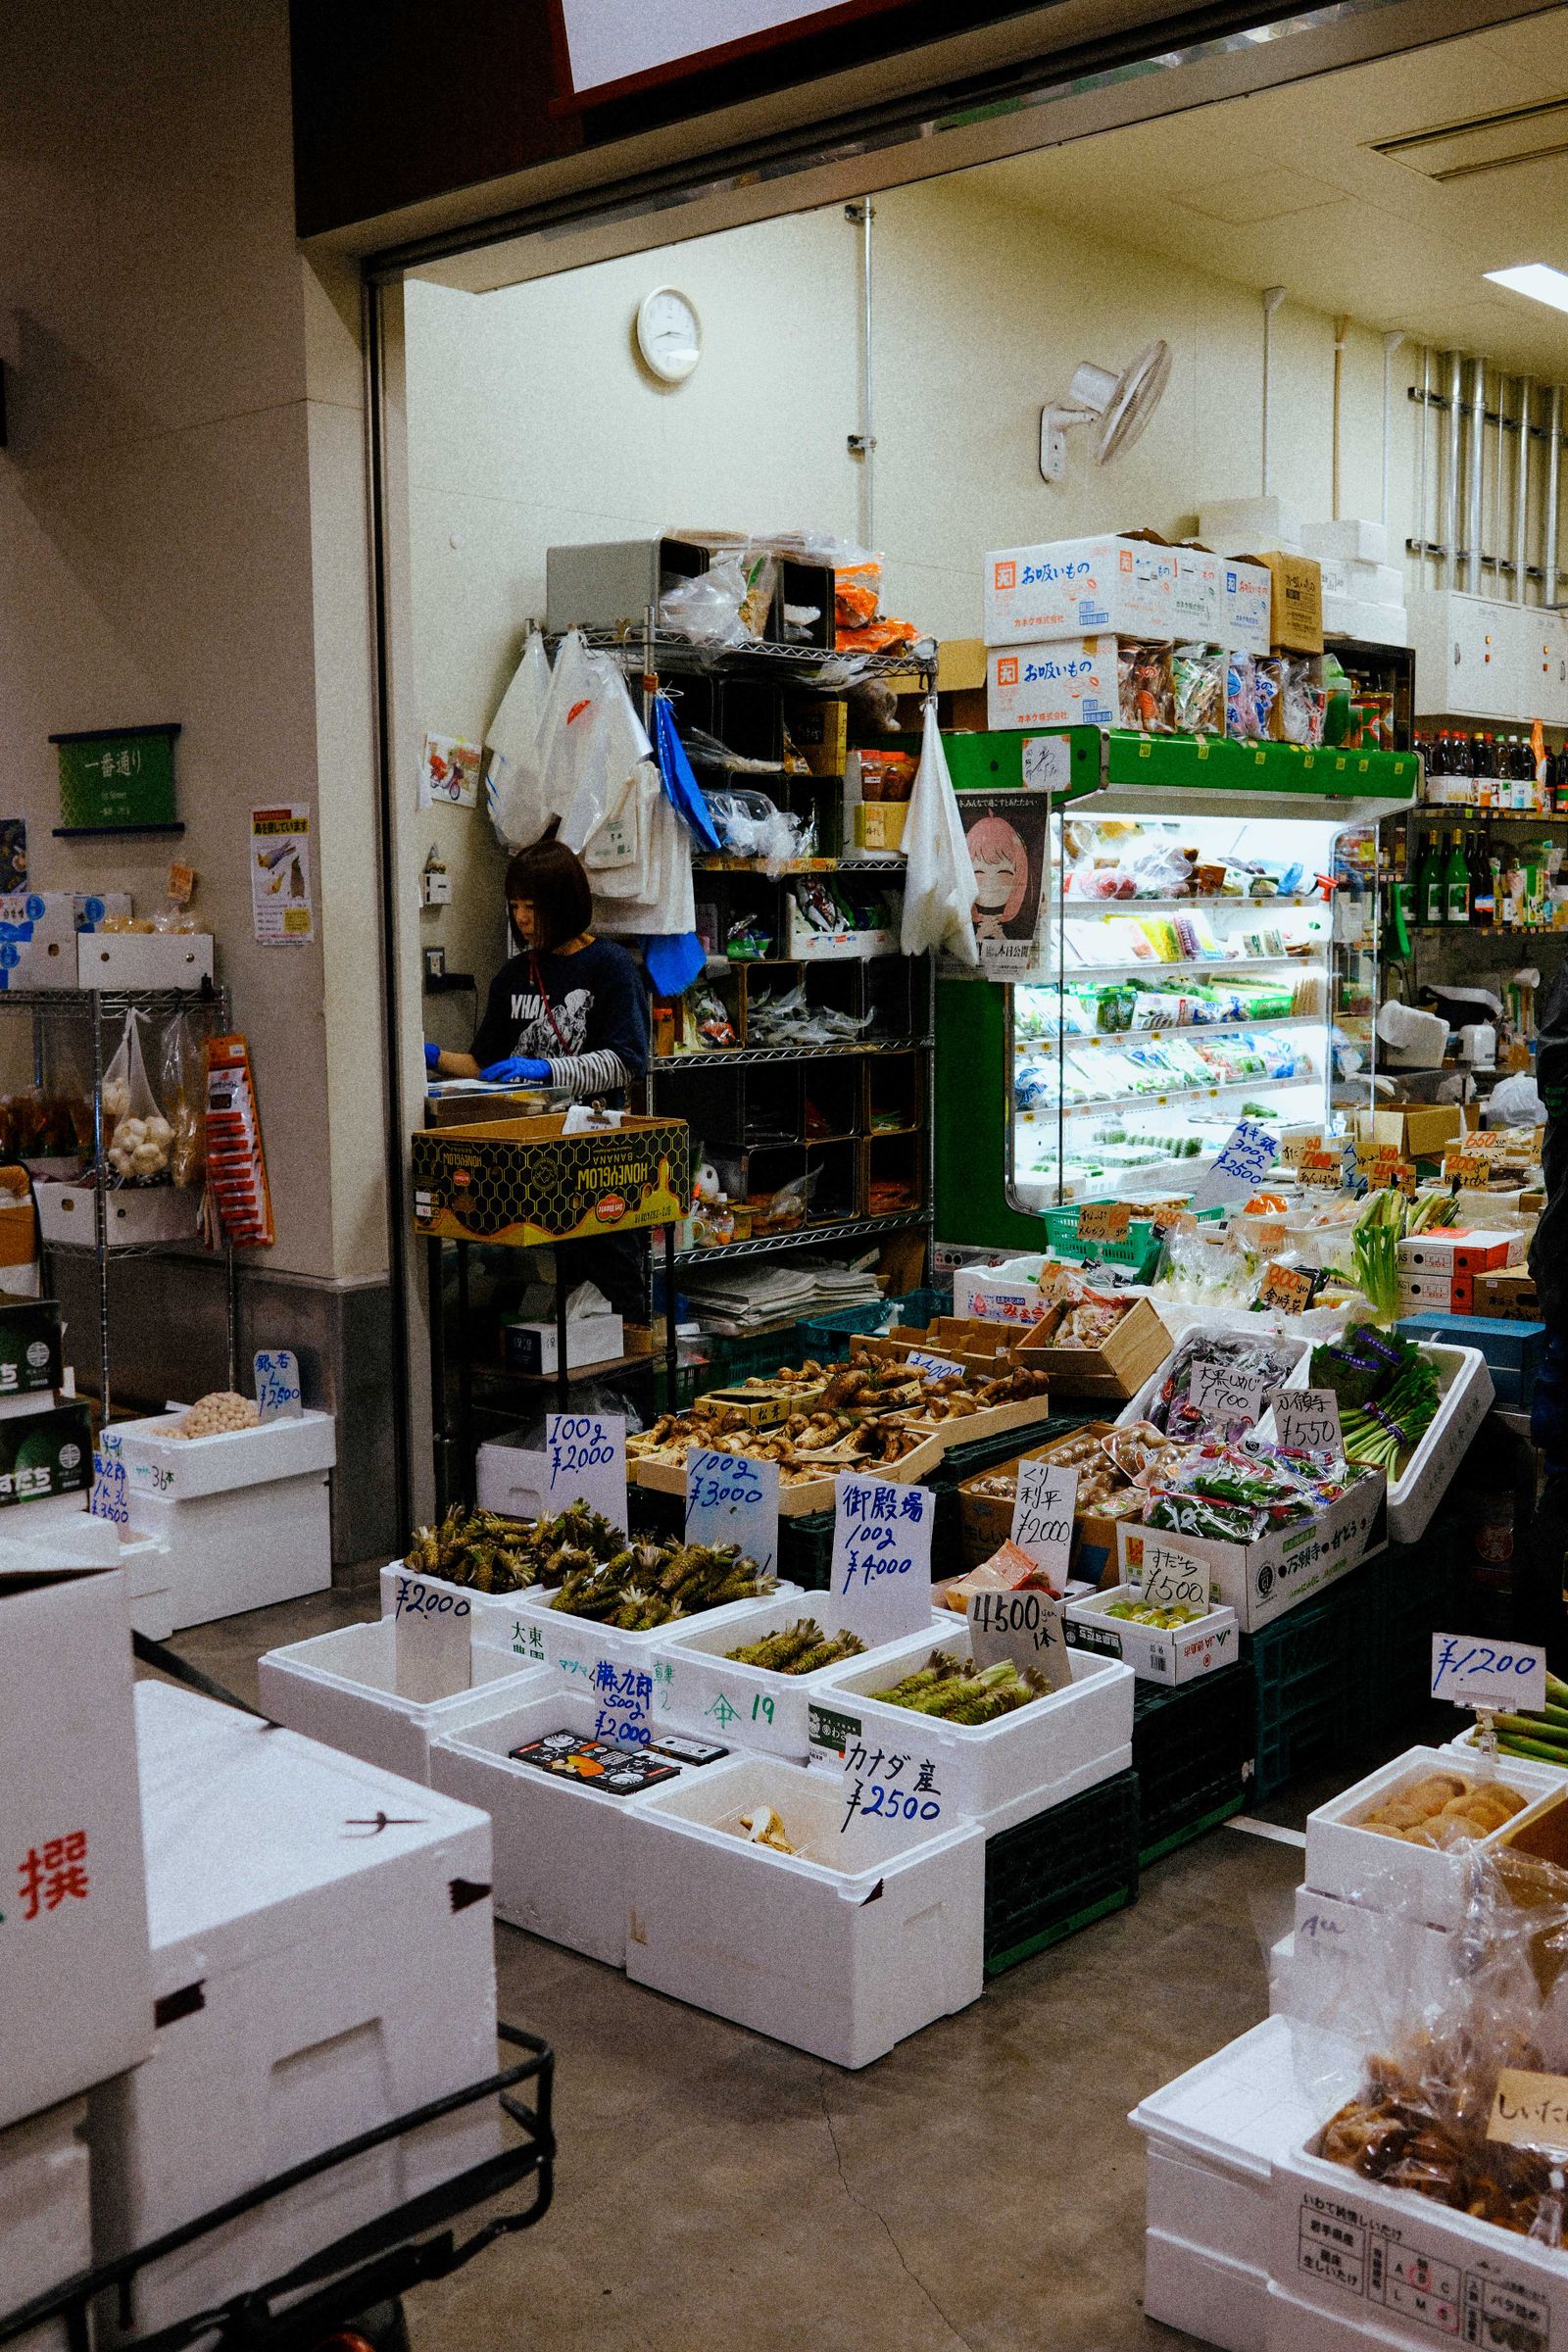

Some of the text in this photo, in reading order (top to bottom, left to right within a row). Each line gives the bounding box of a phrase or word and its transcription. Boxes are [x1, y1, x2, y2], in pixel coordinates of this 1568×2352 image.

[1021, 563, 1090, 585] お吸いもの
[1024, 661, 1092, 682] お吸いもの
[84, 750, 140, 777] 一番通り
[592, 1152, 634, 1165] BANANA
[577, 1161, 649, 1191] HONEYGLOW
[256, 1352, 290, 1372] 銀杏
[1200, 1366, 1260, 1392] 大黒しめじ
[759, 1402, 781, 1421] 松茸
[549, 1415, 608, 1446] 100g
[690, 1452, 758, 1480] 100g
[1023, 1467, 1048, 1486] くり
[843, 1485, 923, 1523] 御殿場
[1021, 1487, 1061, 1511] 利平
[845, 1524, 897, 1550] 100g
[1147, 1548, 1198, 1577] すだち
[973, 1595, 1040, 1632] 4500
[512, 1621, 543, 1648] 大東
[596, 1661, 652, 1709] 藤九郎
[752, 1694, 775, 1725] 19
[845, 1742, 941, 1795] カナダ産
[841, 1779, 941, 1833] ¥2500
[19, 1831, 89, 1921] 撰
[1499, 2093, 1568, 2124] しいた
